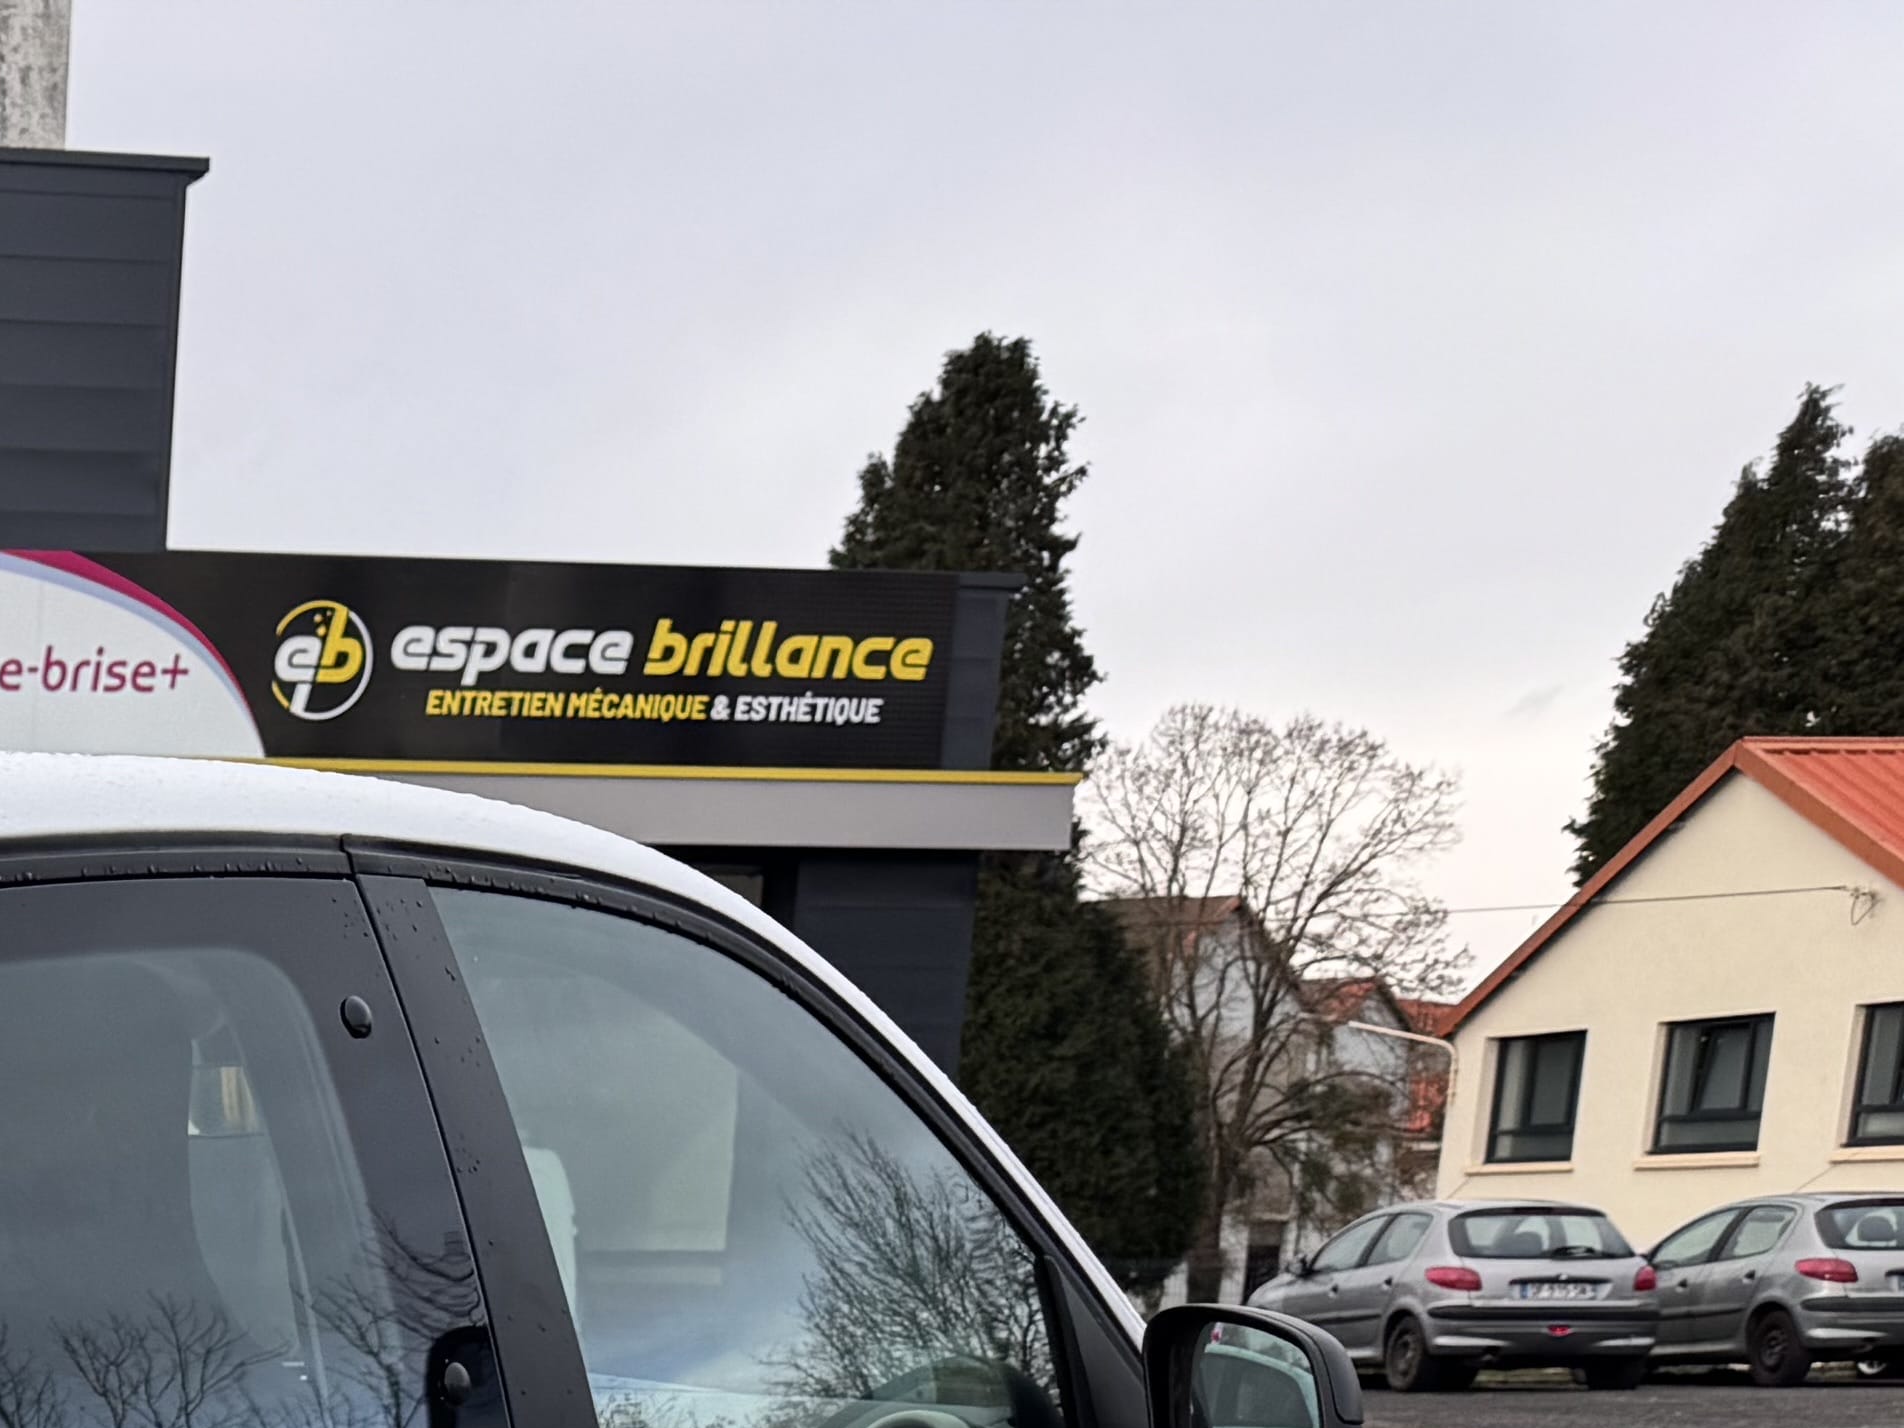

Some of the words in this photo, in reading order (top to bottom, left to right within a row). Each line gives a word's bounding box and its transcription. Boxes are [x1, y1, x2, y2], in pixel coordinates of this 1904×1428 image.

[390, 624, 635, 687] espace
[643, 618, 935, 681] brillance
[424, 688, 564, 719] ENTRETIEN
[566, 685, 711, 723] MÉCANIQUE
[709, 694, 731, 722] &
[733, 690, 885, 727] ESTHÉTIQUE
